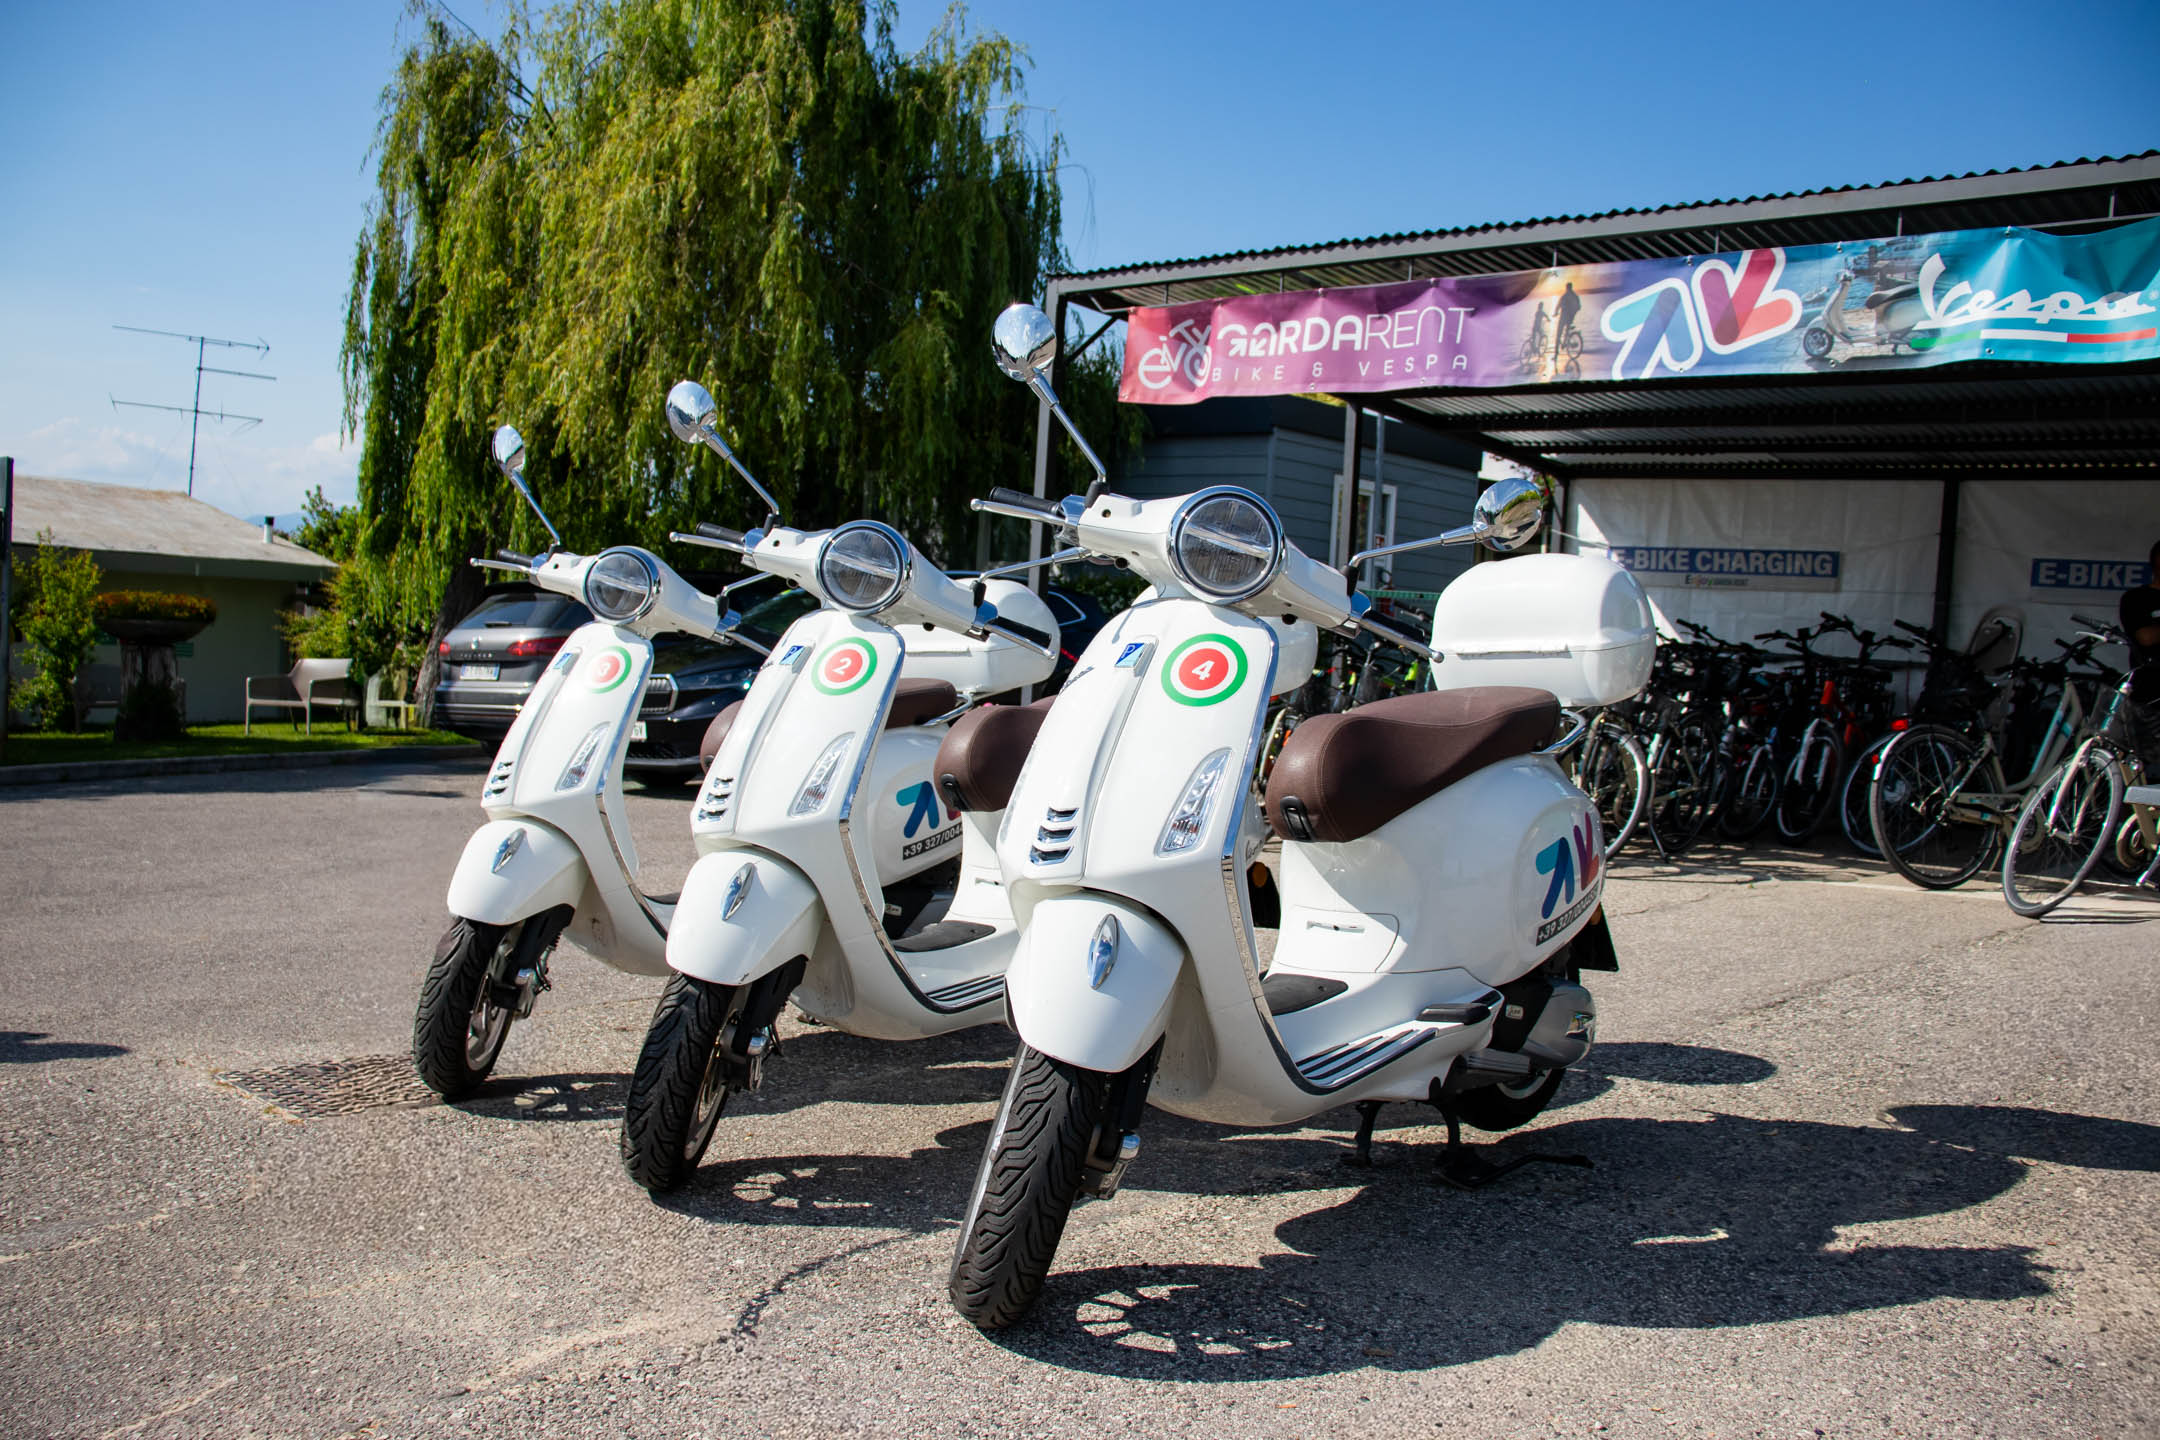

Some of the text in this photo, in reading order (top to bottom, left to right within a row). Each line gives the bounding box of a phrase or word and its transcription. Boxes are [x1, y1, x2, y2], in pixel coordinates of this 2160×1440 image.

[1912, 253, 2157, 331] Vespa
[1212, 354, 1468, 382] BIKE & VESPA
[1616, 549, 1833, 576] E-BIKE CHARGING
[2038, 562, 2145, 587] E-BIKE
[831, 657, 852, 676] 2
[1191, 660, 1215, 681] 4
[903, 825, 962, 858] +39 327/004
[1538, 921, 1557, 942] +39
